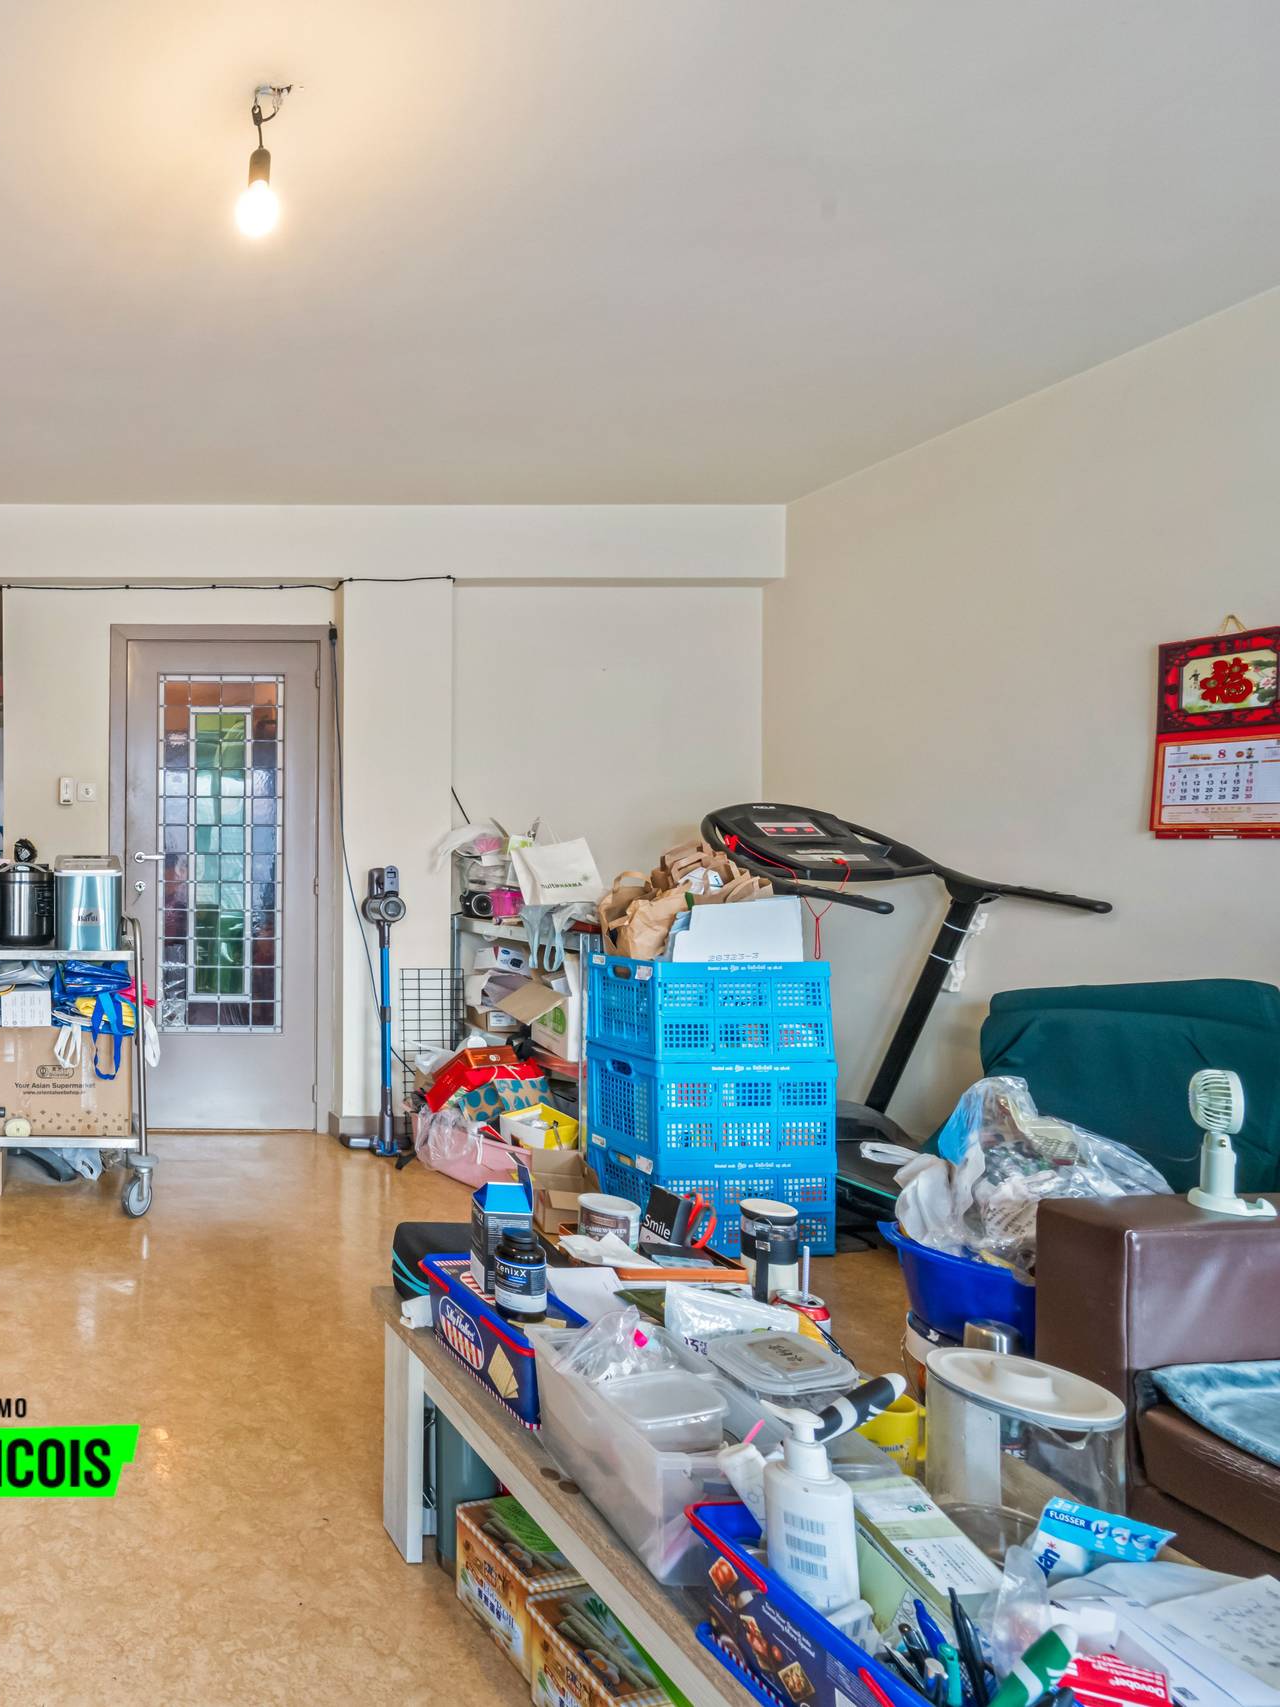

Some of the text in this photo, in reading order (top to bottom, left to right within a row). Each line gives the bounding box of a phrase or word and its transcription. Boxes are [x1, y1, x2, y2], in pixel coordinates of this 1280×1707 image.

[1217, 749, 1227, 759] 8
[643, 1214, 671, 1239] Smile
[495, 1262, 527, 1278] ZenixX
[1049, 1510, 1086, 1528] FLOSSER
